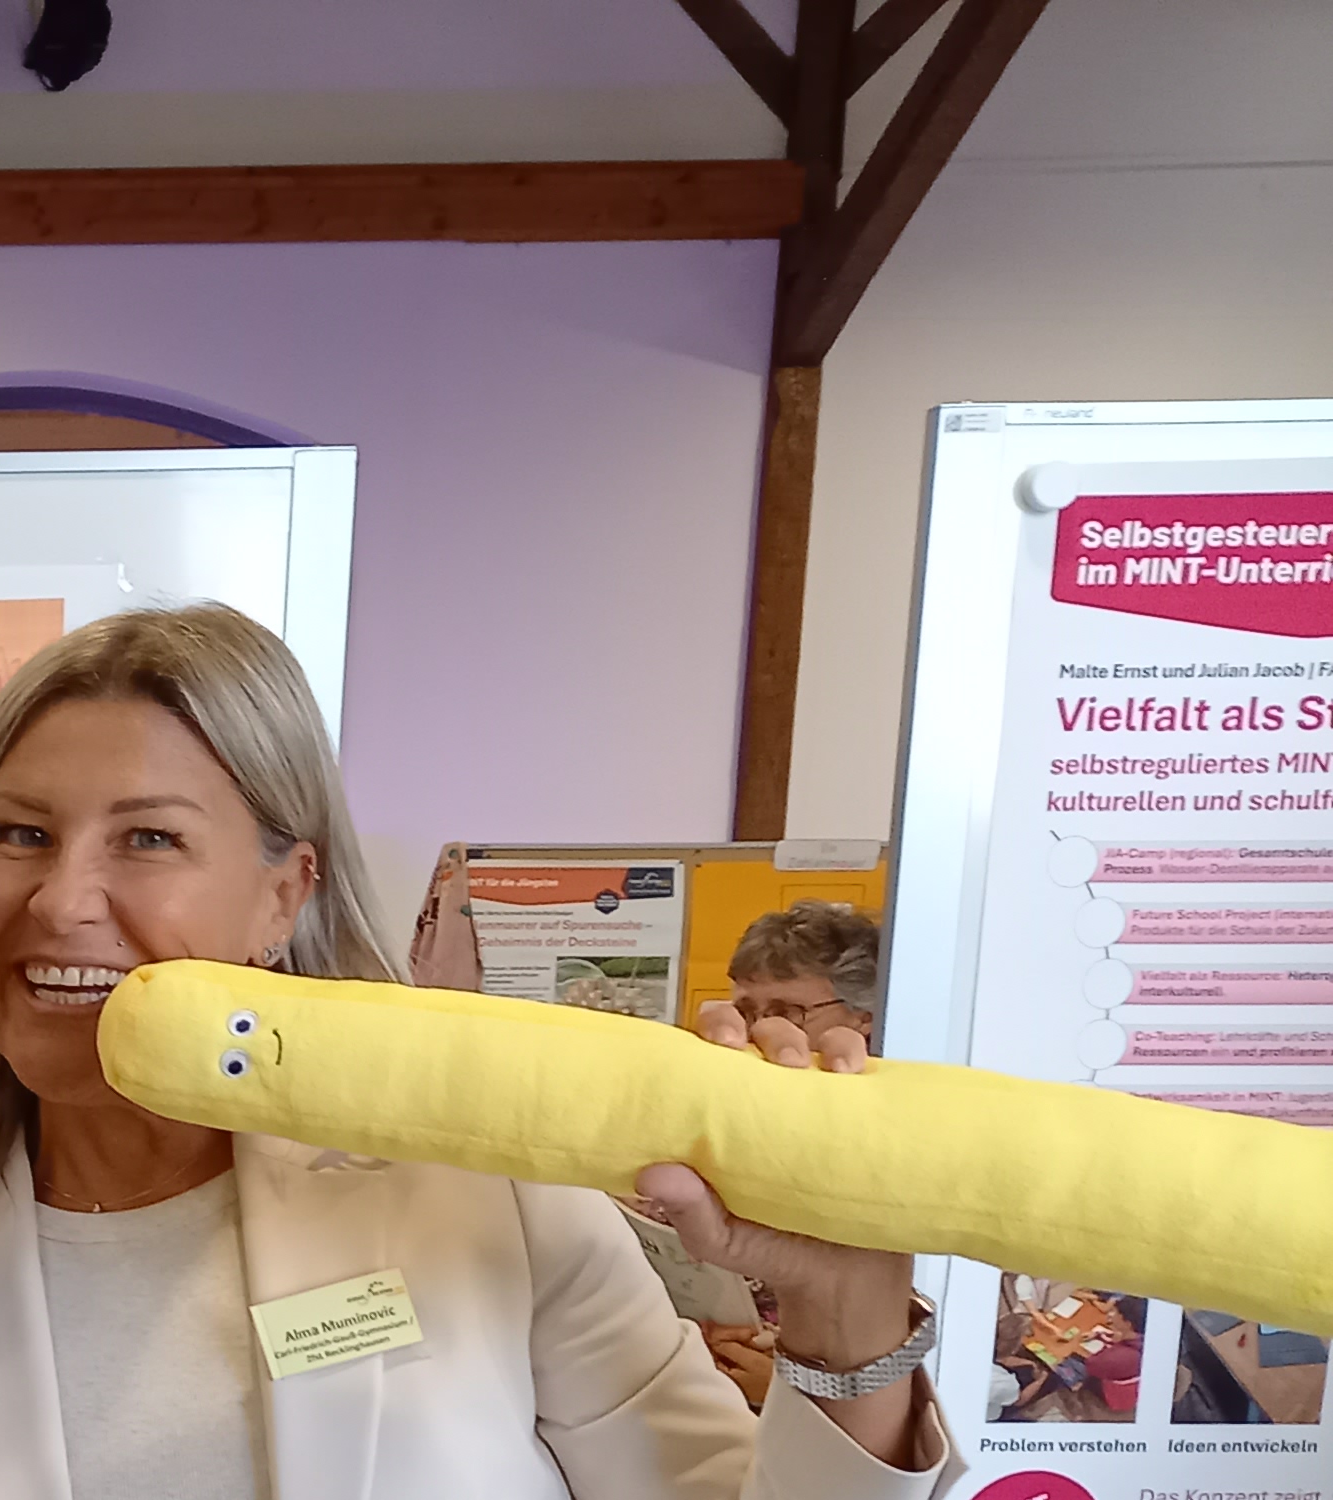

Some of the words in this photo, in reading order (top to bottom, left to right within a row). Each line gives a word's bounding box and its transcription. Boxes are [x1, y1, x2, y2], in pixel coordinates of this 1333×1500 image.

[1077, 556, 1117, 585] im
[1059, 664, 1108, 679] Malte
[1113, 664, 1158, 678] Ernst
[1162, 664, 1195, 678] und
[1198, 663, 1249, 678] Julian
[1253, 663, 1305, 678] Jacob
[1056, 696, 1211, 732] Vielfalt
[1221, 696, 1285, 732] als
[1050, 753, 1269, 780] selbstreguliertes
[1047, 790, 1186, 812] kulturellen
[1193, 790, 1243, 811] und
[285, 1321, 320, 1343] Alma
[321, 1305, 396, 1333] Muminovic
[980, 1439, 1054, 1453] Problem
[1058, 1439, 1147, 1453] verstehen
[1168, 1439, 1217, 1453] Ideen
[1221, 1439, 1318, 1453] entwickeln
